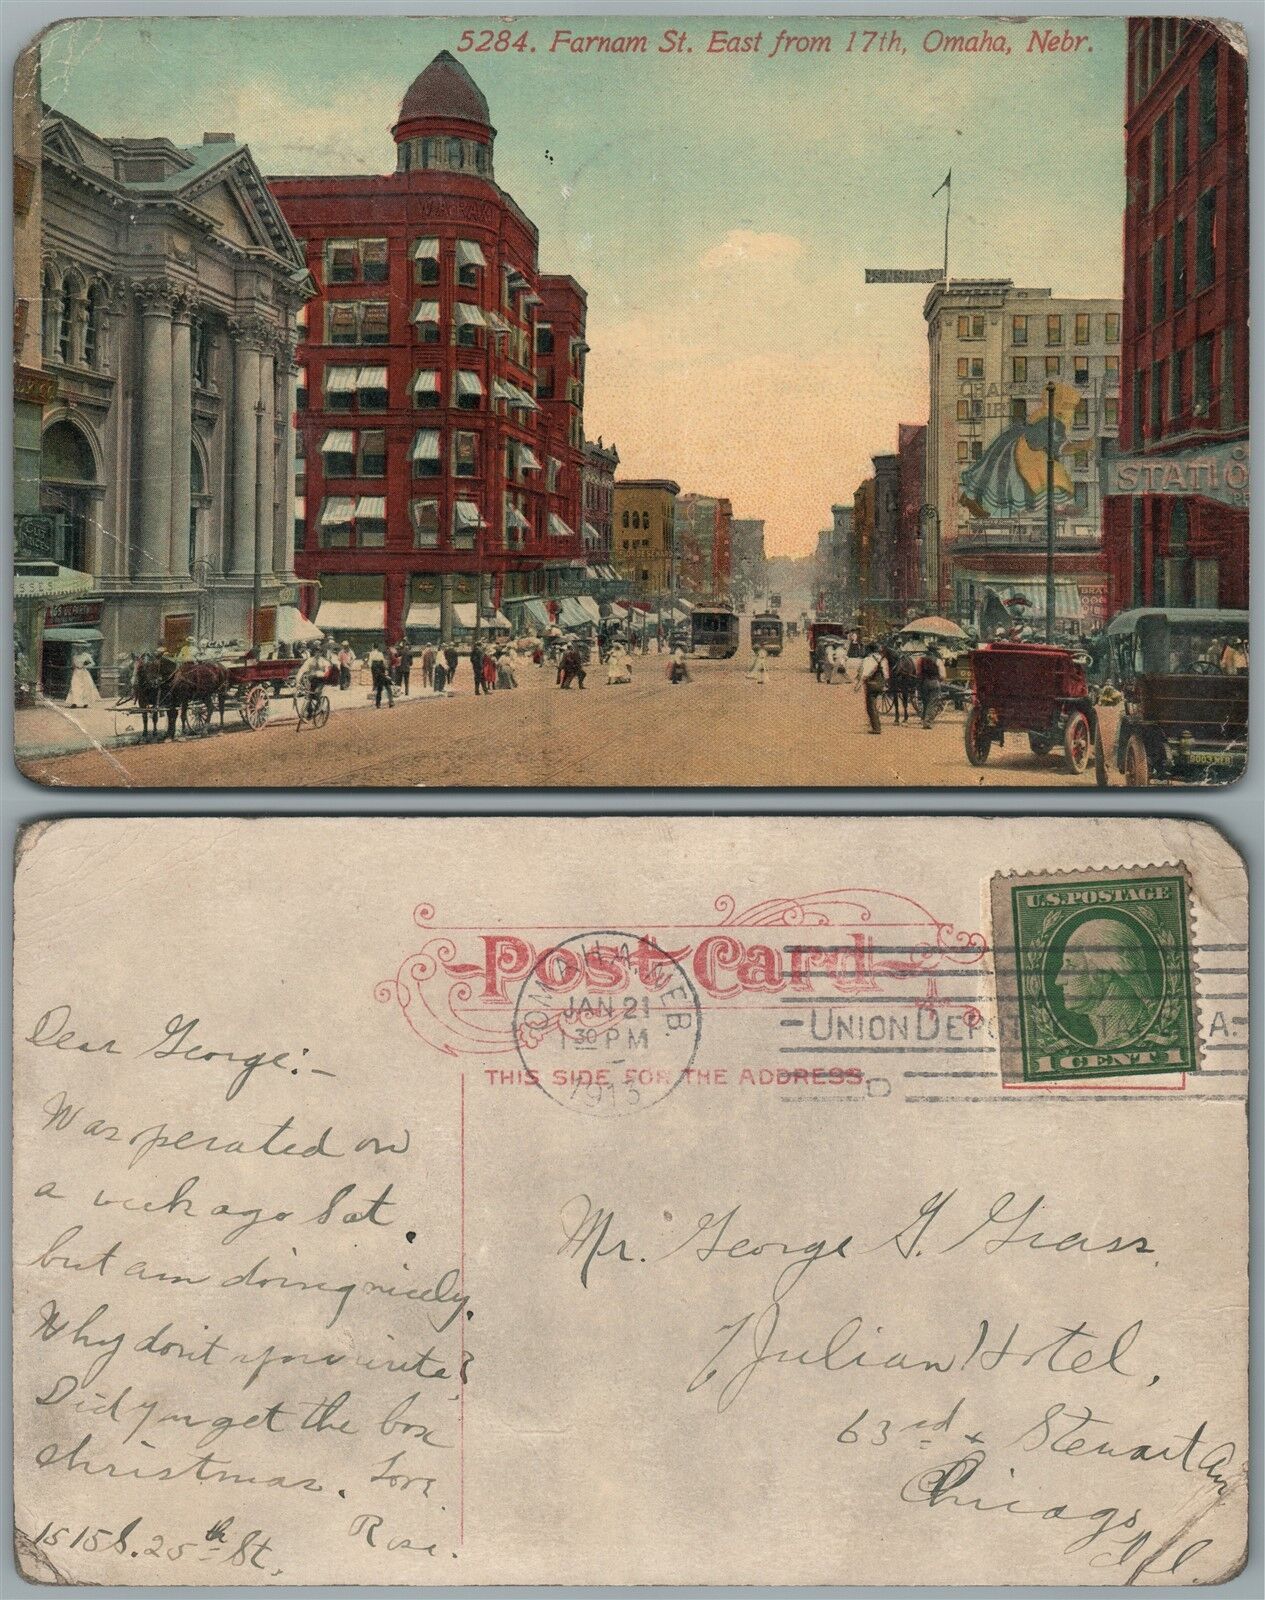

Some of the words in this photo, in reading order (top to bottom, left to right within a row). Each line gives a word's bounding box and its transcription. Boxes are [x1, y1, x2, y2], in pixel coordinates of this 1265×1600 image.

[456, 30, 537, 53] 5284.
[549, 30, 648, 53] Farnam
[659, 30, 694, 53] St.
[707, 30, 761, 53] East
[768, 30, 832, 58] from
[846, 30, 908, 56] 17th,
[922, 30, 1013, 56] Omaha,
[1026, 30, 1095, 53] Nebr.
[475, 933, 693, 1005] Post
[692, 933, 882, 1000] Card
[25, 1005, 122, 1053] Dear
[563, 996, 613, 1019] JAN
[623, 996, 650, 1019] 21
[484, 1069, 540, 1086] THIS
[552, 1068, 611, 1086] SIDE
[625, 1068, 672, 1086] FOR
[683, 1068, 728, 1086] THE
[1060, 1051, 1157, 1069] CENT
[43, 1091, 121, 1143] Was
[355, 1129, 410, 1155] on
[34, 1181, 65, 1200] a
[210, 1202, 293, 1245] ago
[27, 1225, 122, 1270] but
[124, 1261, 209, 1285] am
[220, 1247, 357, 1329] doing
[557, 1193, 648, 1289] Mr.
[664, 1204, 853, 1304] George
[29, 1300, 126, 1388] Why
[228, 1345, 347, 1390] you
[717, 1302, 957, 1414] Julian
[36, 1375, 133, 1422] Did
[196, 1401, 287, 1449] get
[300, 1390, 360, 1436] the
[379, 1391, 456, 1449] box
[1007, 1403, 1207, 1472] Stewart
[900, 1448, 1142, 1552] Chicago
